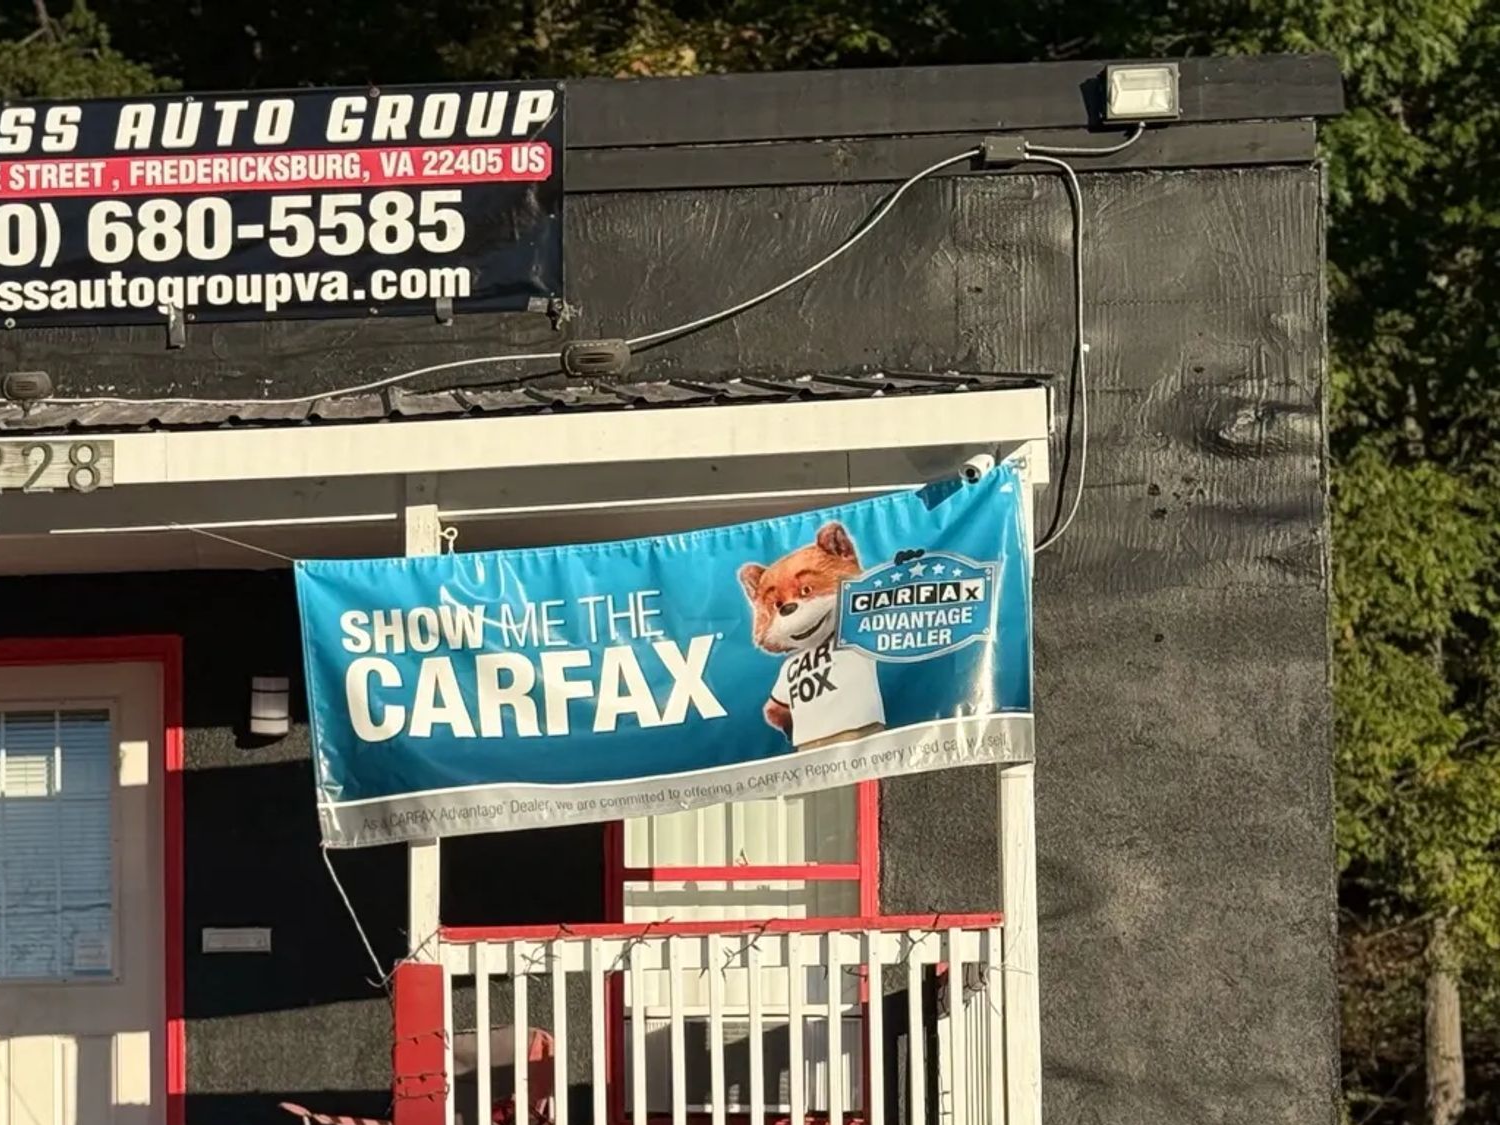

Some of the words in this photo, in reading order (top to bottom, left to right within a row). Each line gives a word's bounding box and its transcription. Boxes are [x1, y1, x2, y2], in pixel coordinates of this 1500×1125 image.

[114, 99, 295, 150] AUTO
[326, 89, 555, 142] GROUP
[9, 160, 106, 190] STREET
[130, 153, 370, 187] FREDERICKSBURG,
[380, 151, 414, 178] VA
[422, 148, 503, 176] 22405
[511, 145, 545, 173] US
[87, 189, 465, 264] 680-5585
[852, 581, 981, 612] CARFAX
[340, 604, 486, 654] SHOW
[500, 599, 569, 648] ME
[579, 590, 666, 643] THE
[858, 606, 973, 633] ADVANTAGE
[877, 629, 952, 651] DEALER
[787, 639, 834, 684] CAR
[345, 632, 728, 743] CARFAX
[789, 667, 838, 710] FOX
[389, 808, 437, 827] CARFAX
[440, 802, 505, 821] Advantage
[509, 798, 552, 815] Dealer,
[555, 799, 574, 811] we
[577, 799, 596, 812] are
[599, 789, 665, 809] committed
[668, 788, 681, 801] to
[683, 781, 733, 800] offering
[747, 768, 798, 790] CARFAX
[805, 760, 847, 779] Report
[851, 757, 867, 770] on
[870, 747, 905, 767] every
[943, 738, 961, 753] ca
